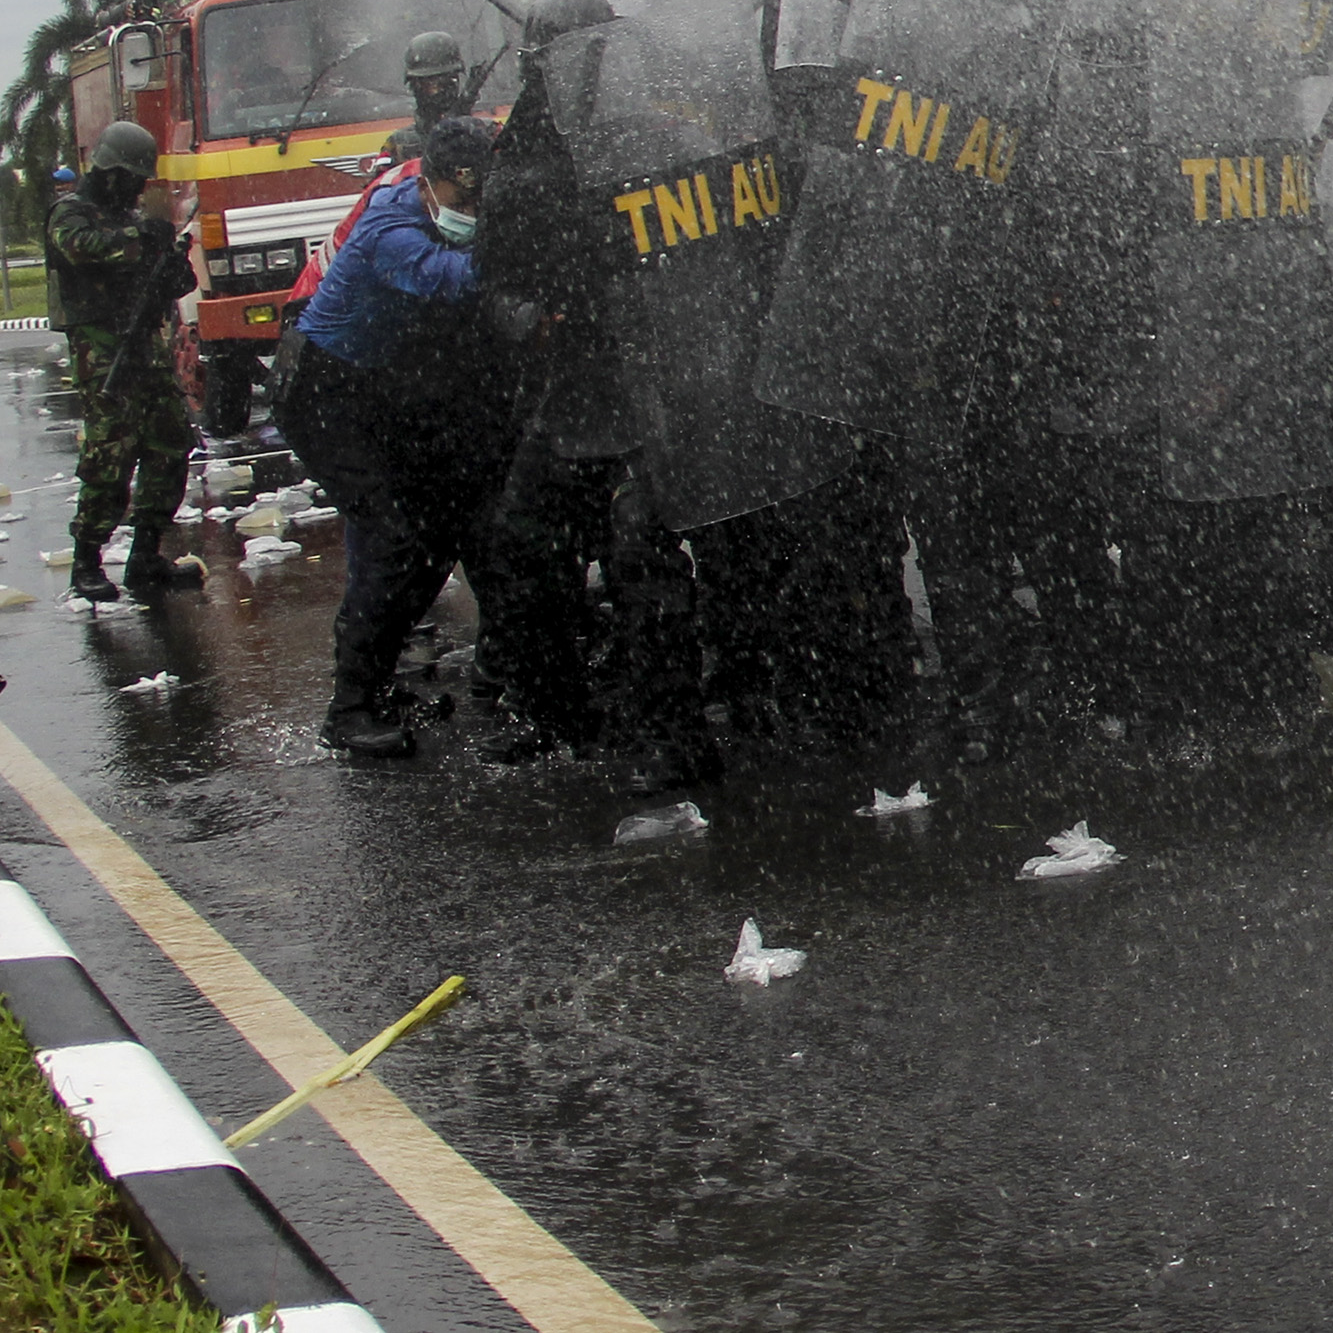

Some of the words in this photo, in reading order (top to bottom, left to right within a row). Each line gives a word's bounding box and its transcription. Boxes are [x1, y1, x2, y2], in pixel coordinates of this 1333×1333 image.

[854, 77, 950, 161] TNI
[953, 116, 1021, 184] AU
[614, 169, 718, 254] TNI
[732, 154, 780, 227] AU
[1181, 156, 1267, 221] TNI
